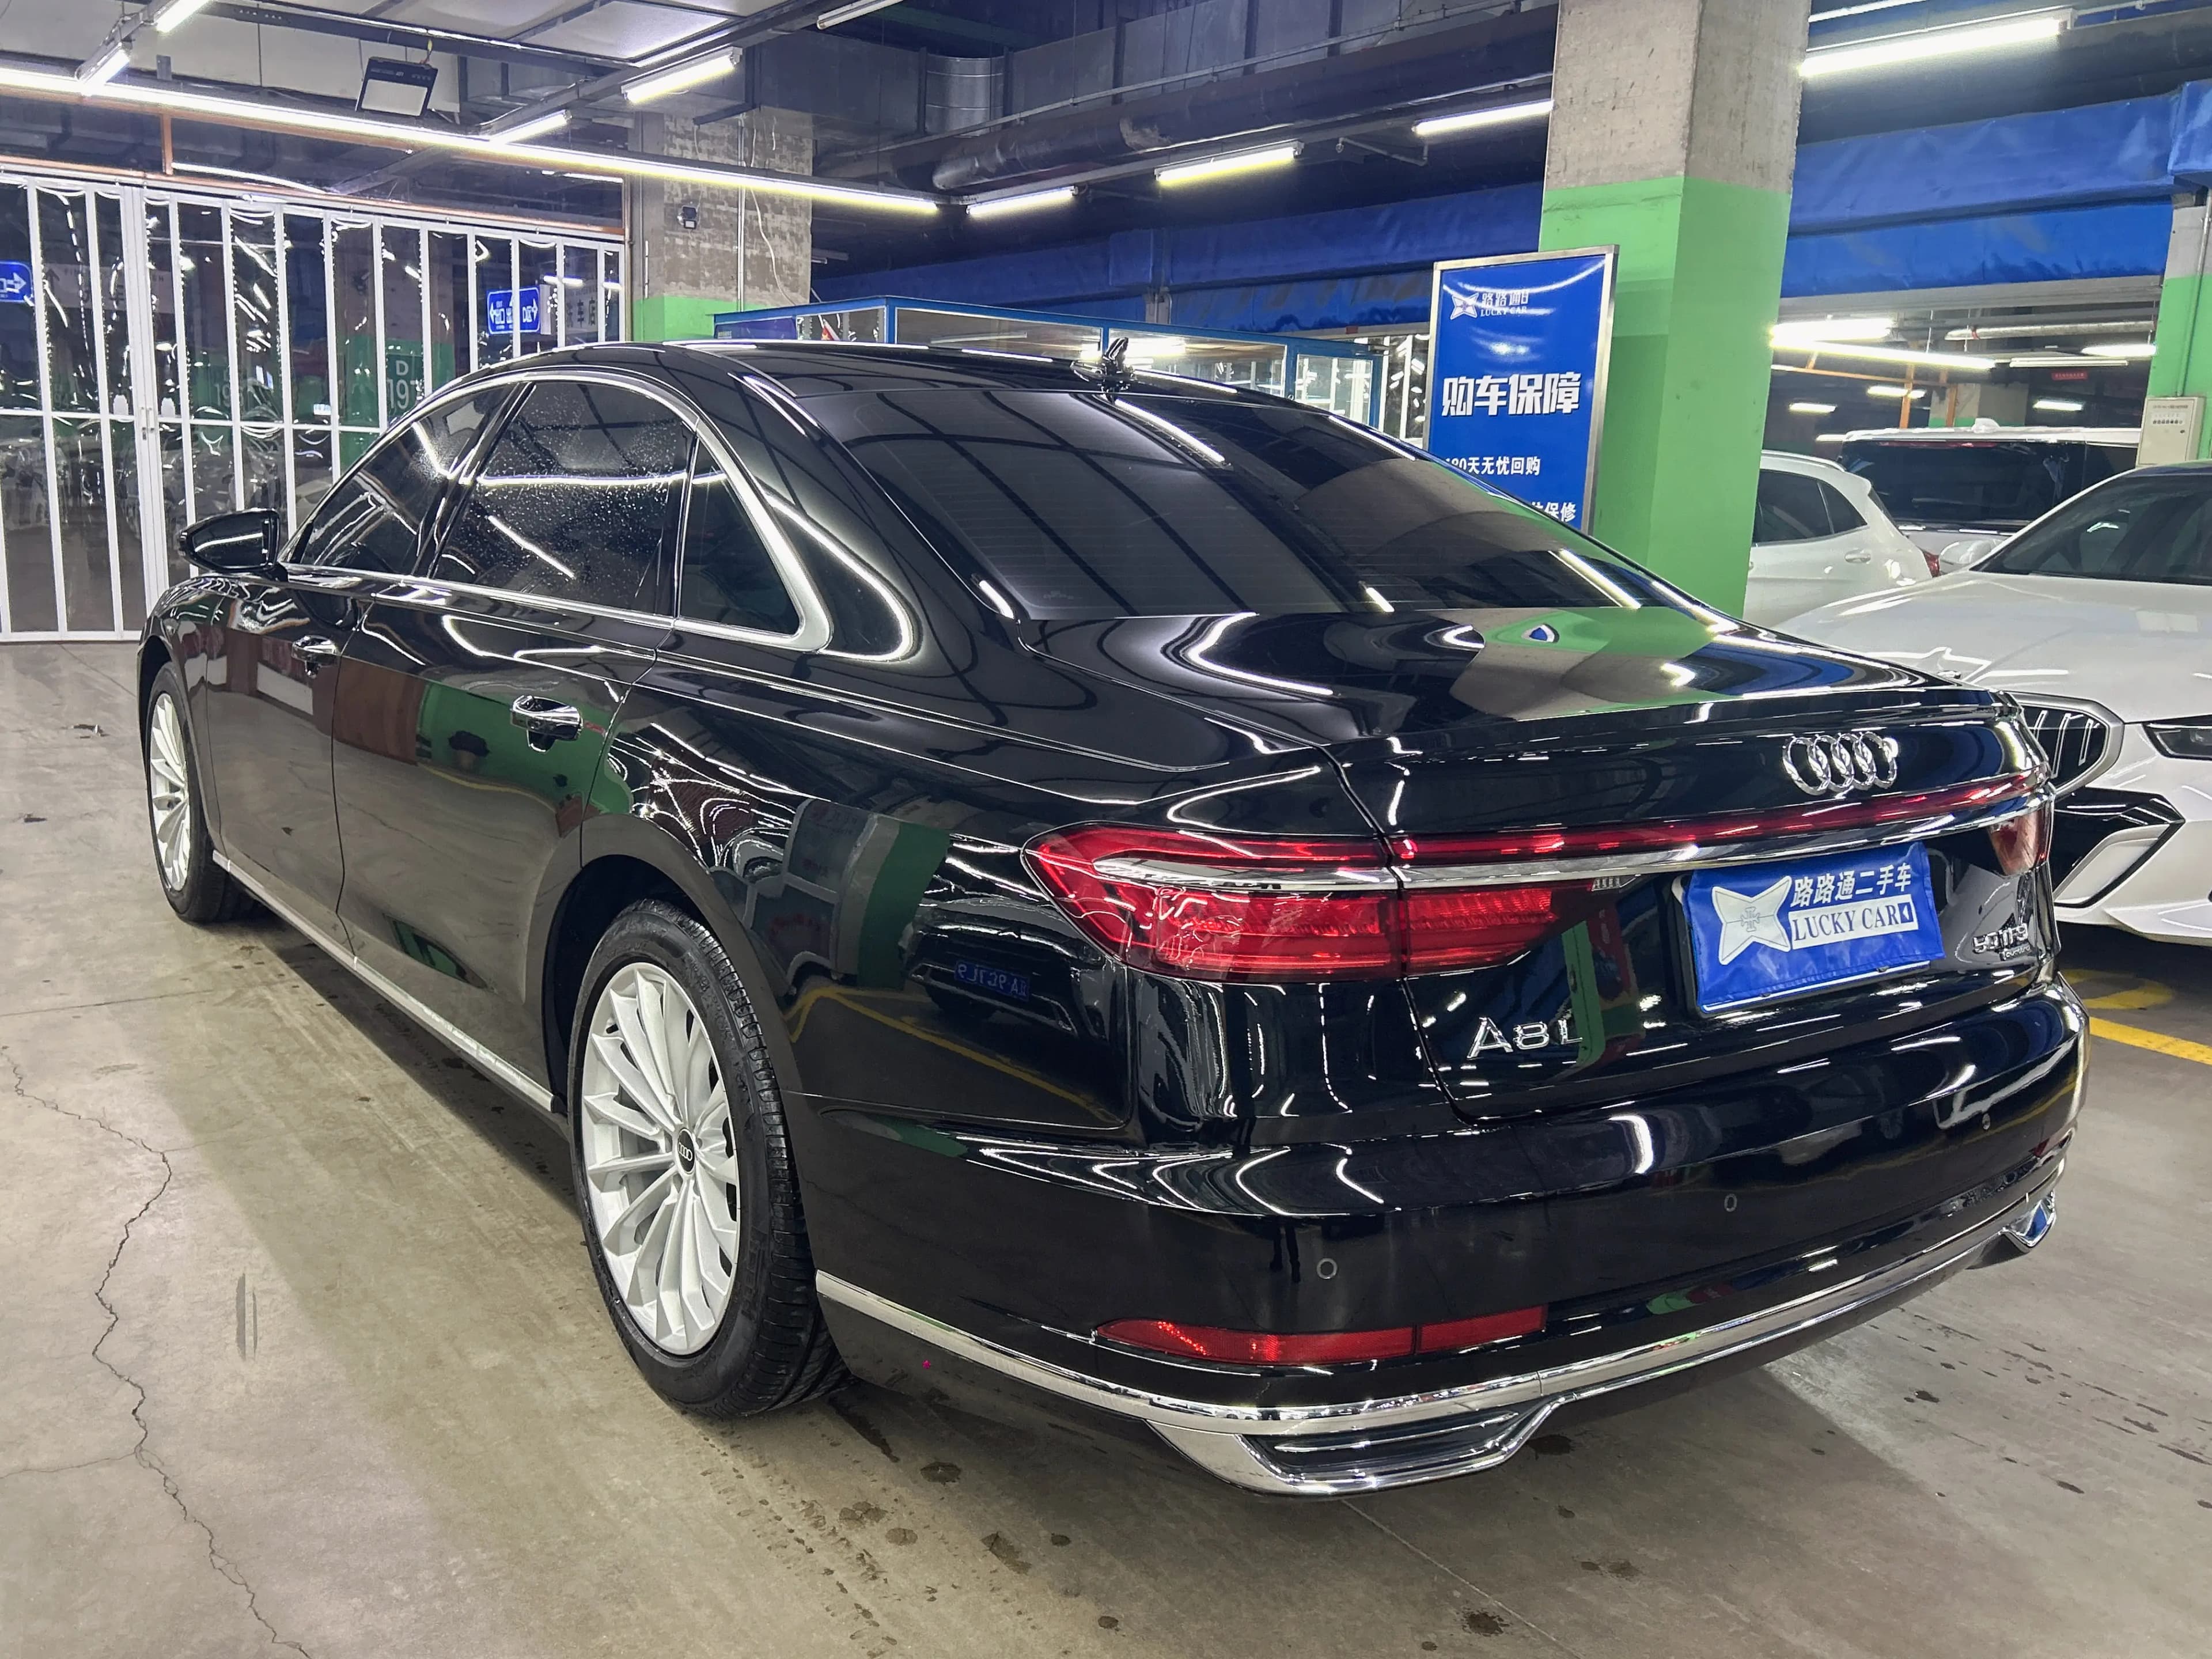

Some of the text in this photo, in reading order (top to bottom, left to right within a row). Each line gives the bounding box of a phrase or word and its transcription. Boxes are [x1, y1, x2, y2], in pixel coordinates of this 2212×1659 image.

[1441, 372, 1581, 417] 购车保障
[1790, 862, 1912, 907] 路路通二手车
[1793, 904, 1899, 941] LUCKY CAR
[1467, 1016, 1583, 1060] A8L
